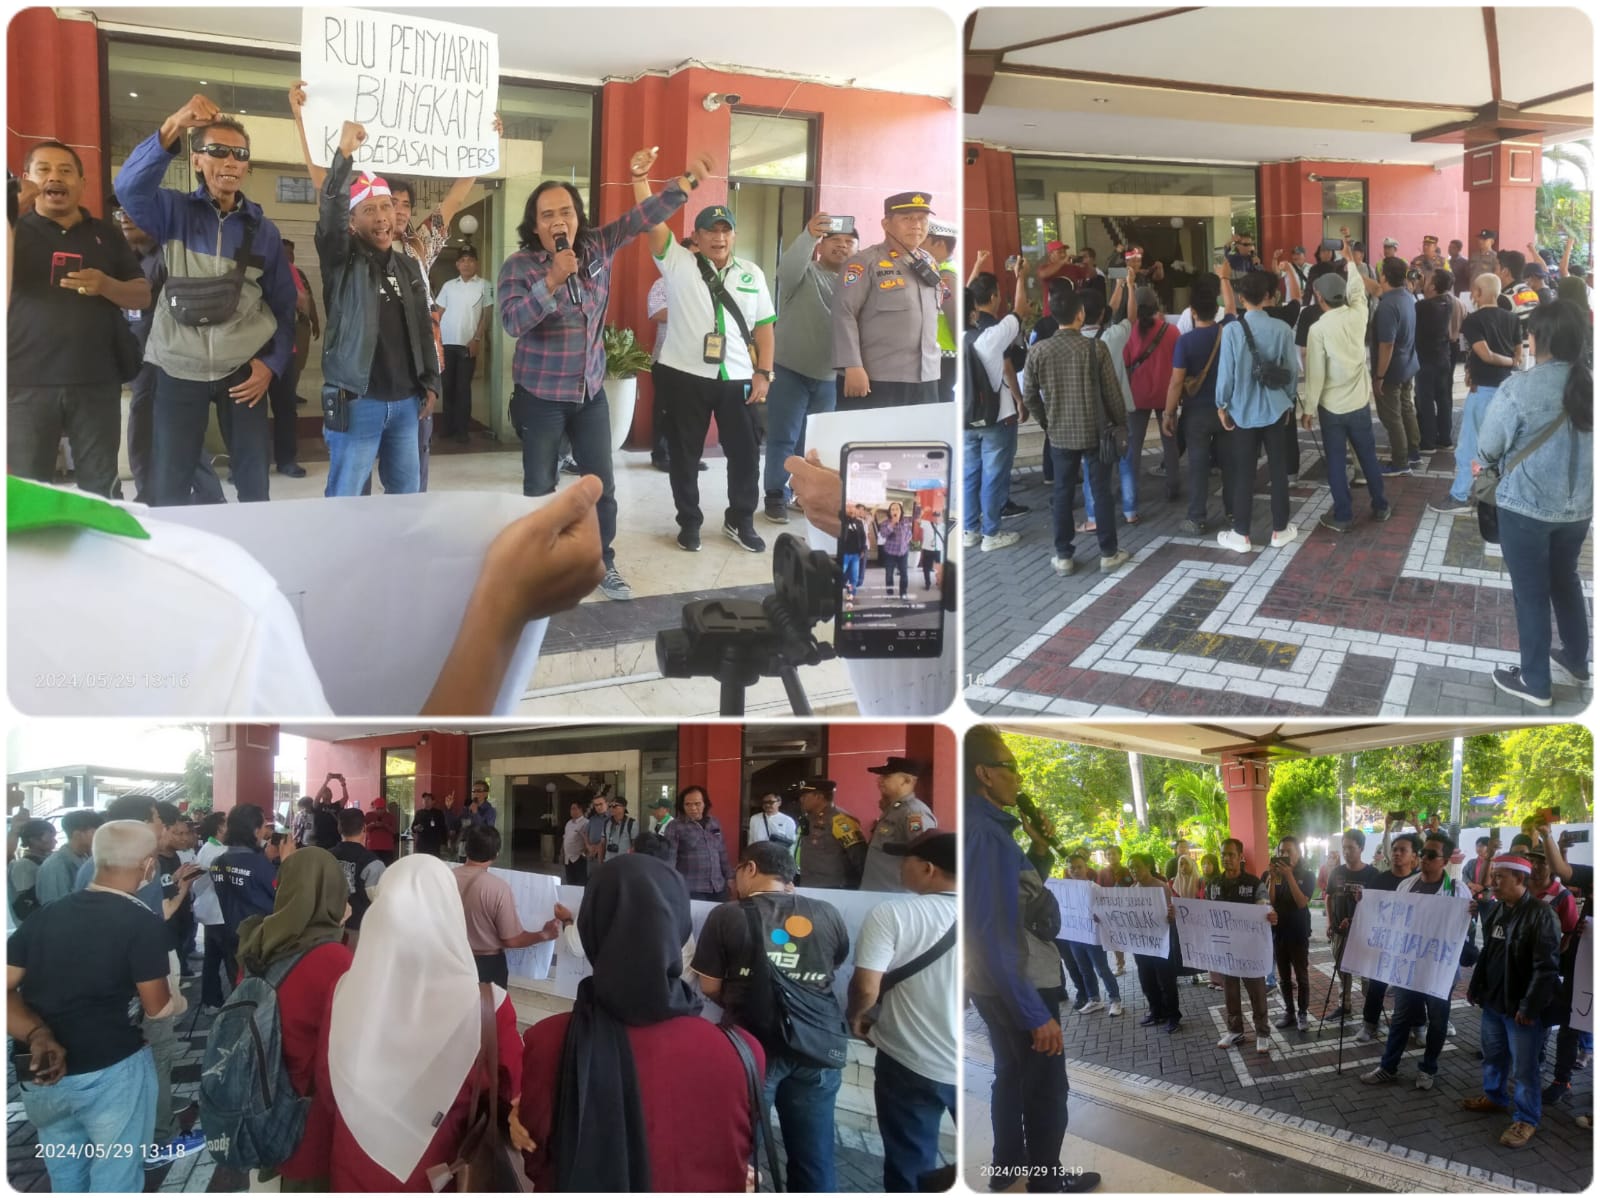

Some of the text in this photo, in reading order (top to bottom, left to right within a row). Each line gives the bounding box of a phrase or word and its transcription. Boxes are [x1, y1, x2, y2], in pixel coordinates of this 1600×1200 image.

[325, 16, 489, 89] RUU PENYIARAN
[353, 74, 484, 141] BUNGKAM
[324, 125, 496, 171] KBEBASAN PERS
